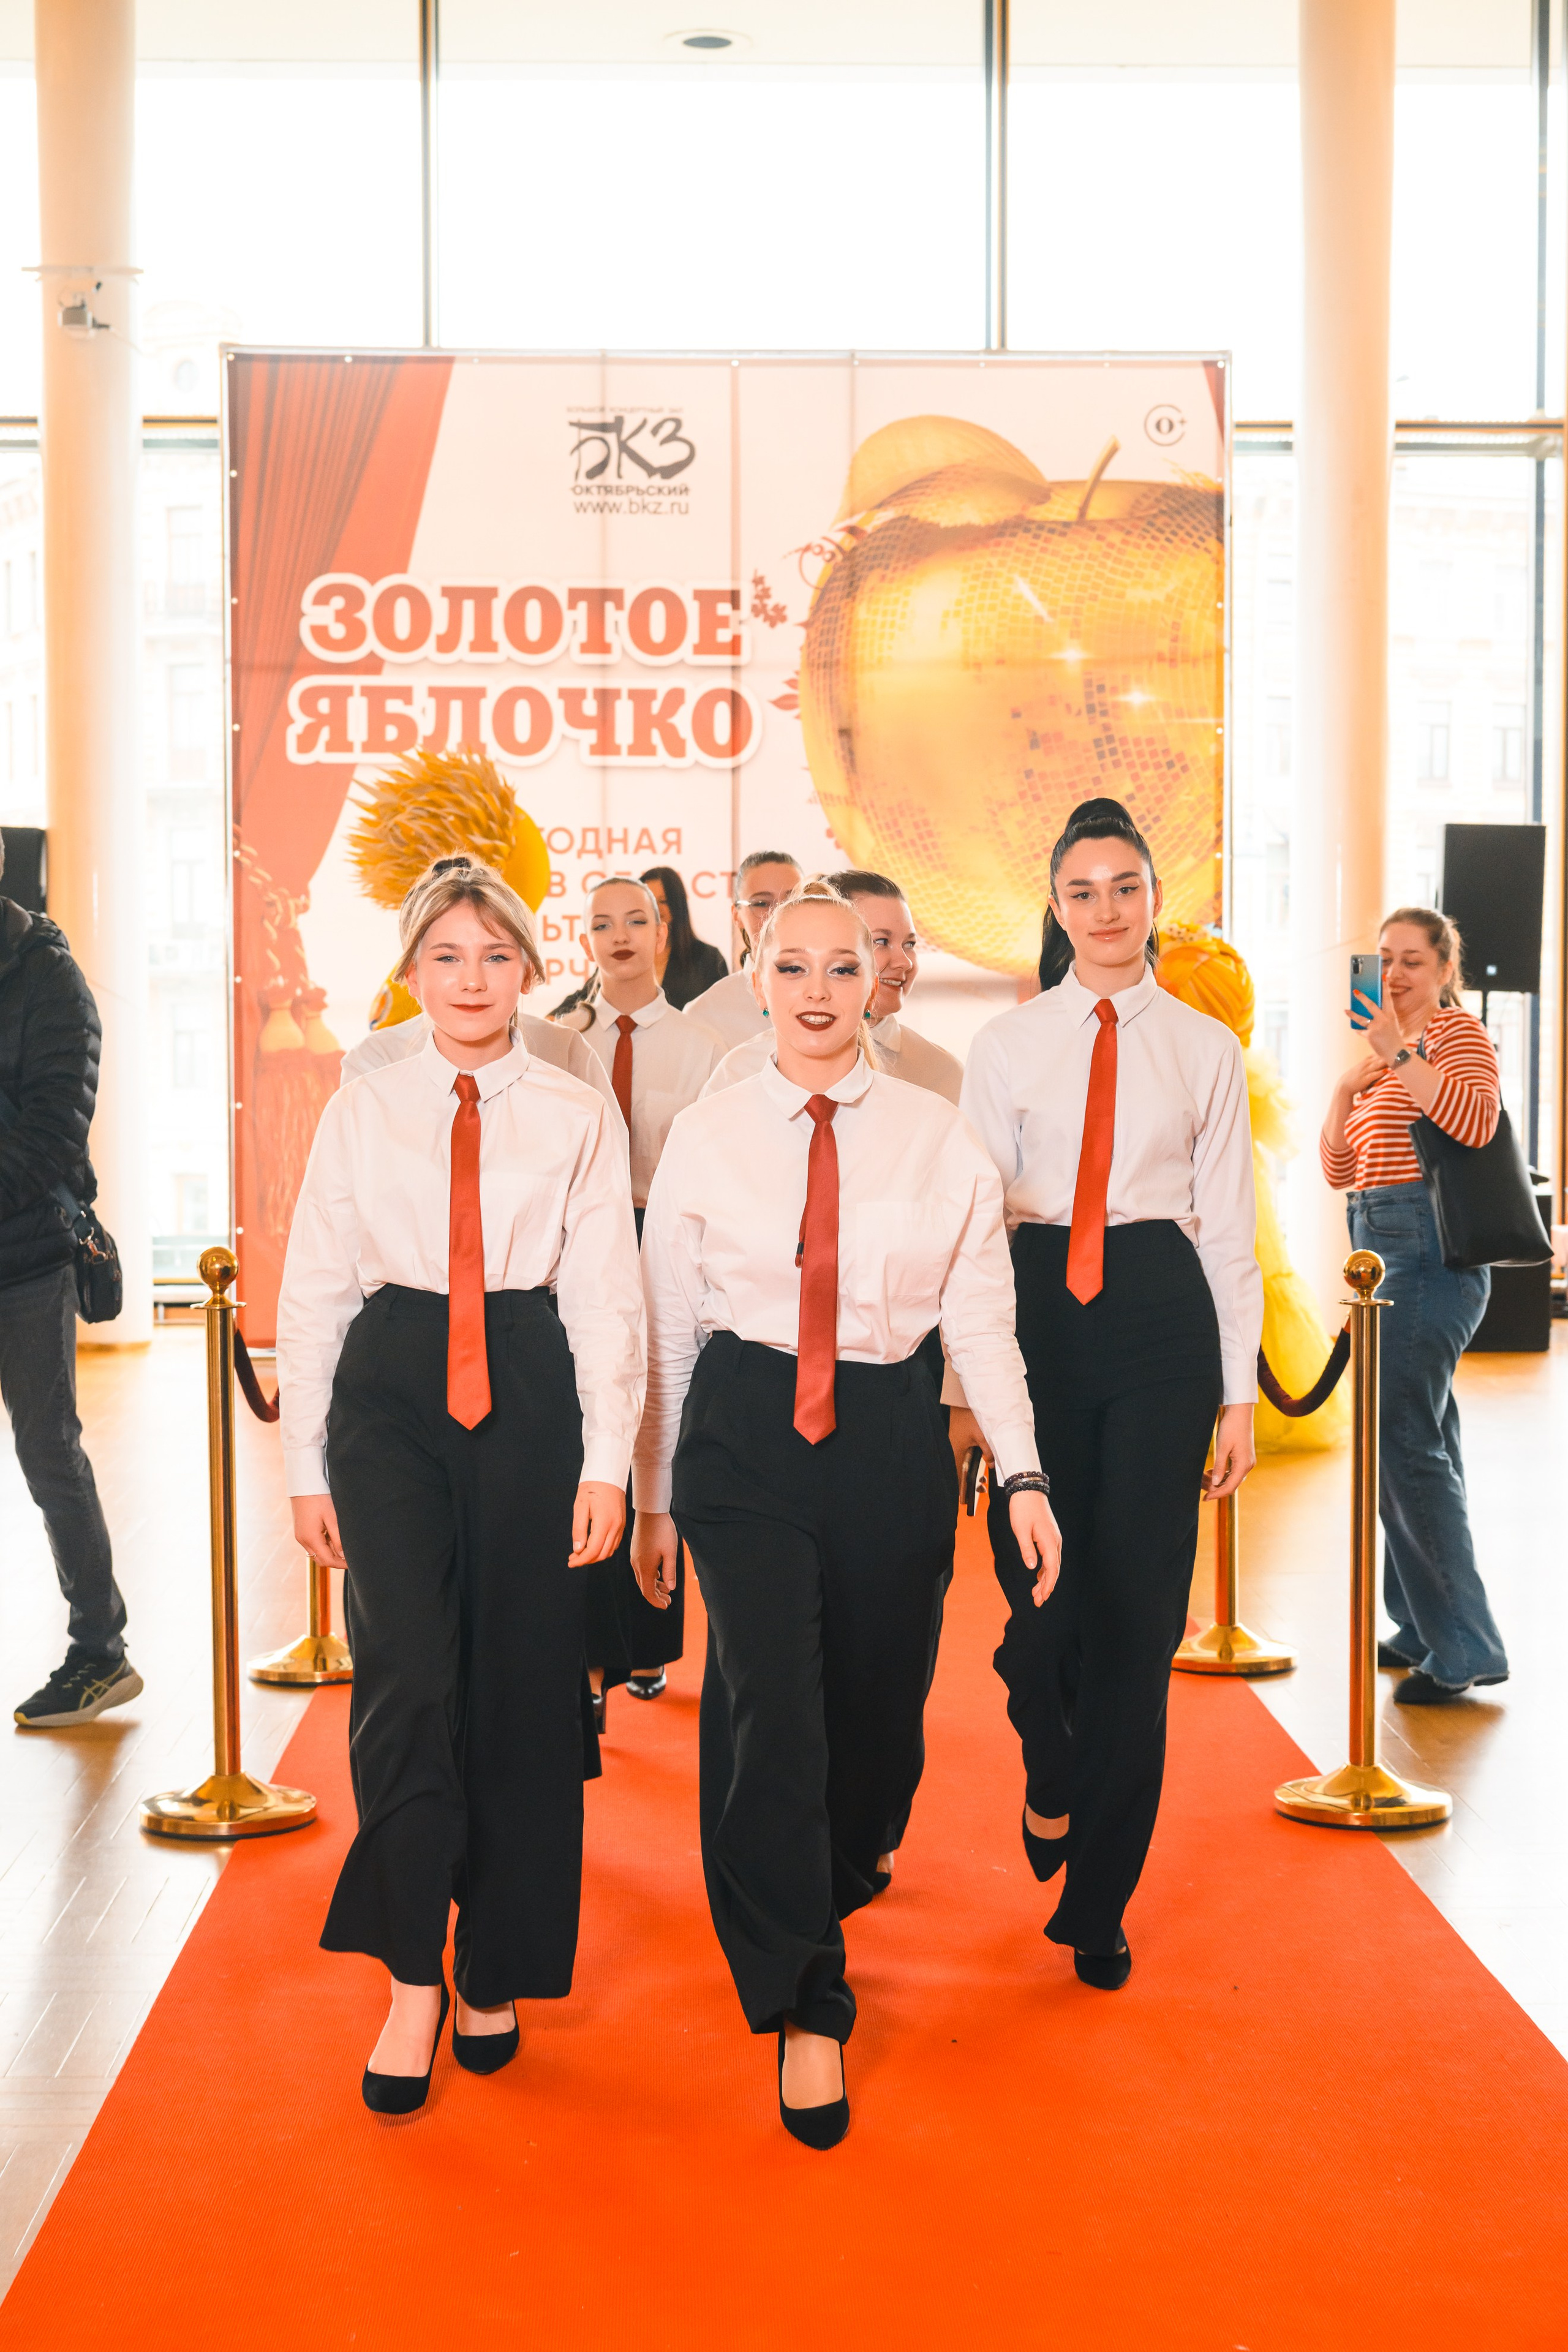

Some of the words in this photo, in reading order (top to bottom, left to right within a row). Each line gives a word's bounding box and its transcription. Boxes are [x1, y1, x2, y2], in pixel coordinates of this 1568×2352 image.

[572, 483, 690, 497] ОКТЯБРЬСКИЙ
[573, 498, 690, 514] www.bkz.ru
[309, 582, 741, 657] ЗОЛОТОЕ
[296, 685, 753, 759] ЯБЛОЧКО
[538, 827, 682, 859] ОДНАЯ
